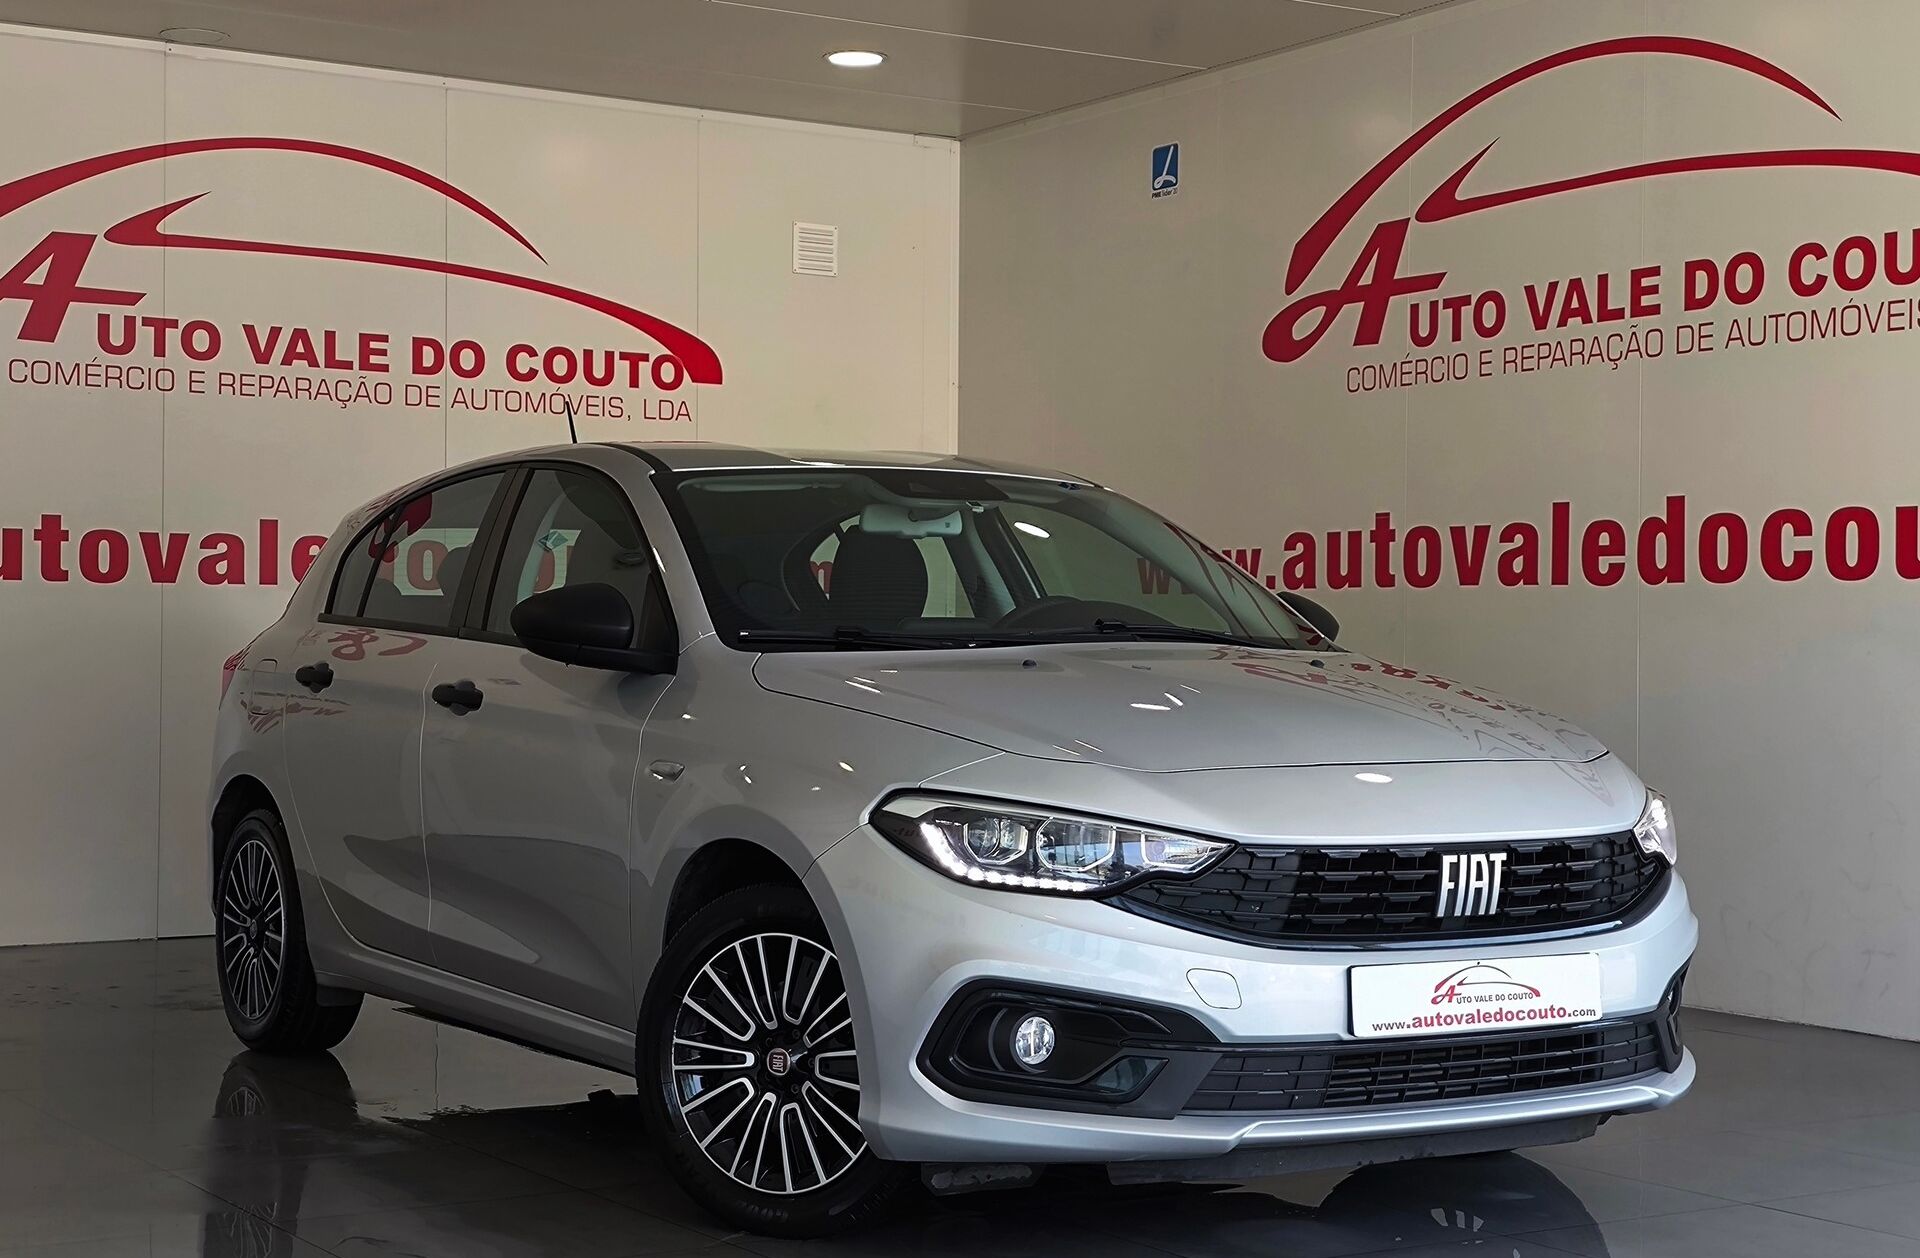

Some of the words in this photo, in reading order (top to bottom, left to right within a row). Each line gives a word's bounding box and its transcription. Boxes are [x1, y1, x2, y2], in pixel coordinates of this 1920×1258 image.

[1524, 265, 1661, 331] VALE
[1683, 251, 1765, 312] DO
[1788, 228, 1920, 298] COU
[242, 323, 390, 373] VALE
[411, 336, 486, 379] DO
[506, 343, 684, 391] COUTO
[1347, 352, 1469, 393] COMÉRCIO
[1479, 349, 1493, 377] E
[1503, 323, 1663, 375] REPARAÇÃO
[1676, 321, 1714, 354] DE
[1725, 298, 1920, 349] AUTOMÓVEI
[8, 357, 175, 392] COMÉRCIO
[189, 371, 206, 393] E
[218, 372, 393, 409] REPARAÇÃO
[404, 384, 441, 408] DE
[451, 387, 632, 421] AUTOMÓVEIS,
[643, 398, 692, 422] LDA
[1437, 852, 1507, 918] FIAT
[1372, 1004, 1597, 1031] www.autovaledocouto.com
[1474, 994, 1493, 1002] VALE
[1495, 993, 1506, 1002] DO
[1508, 992, 1534, 1001] COUTO
[772, 1054, 784, 1072] FIAT
